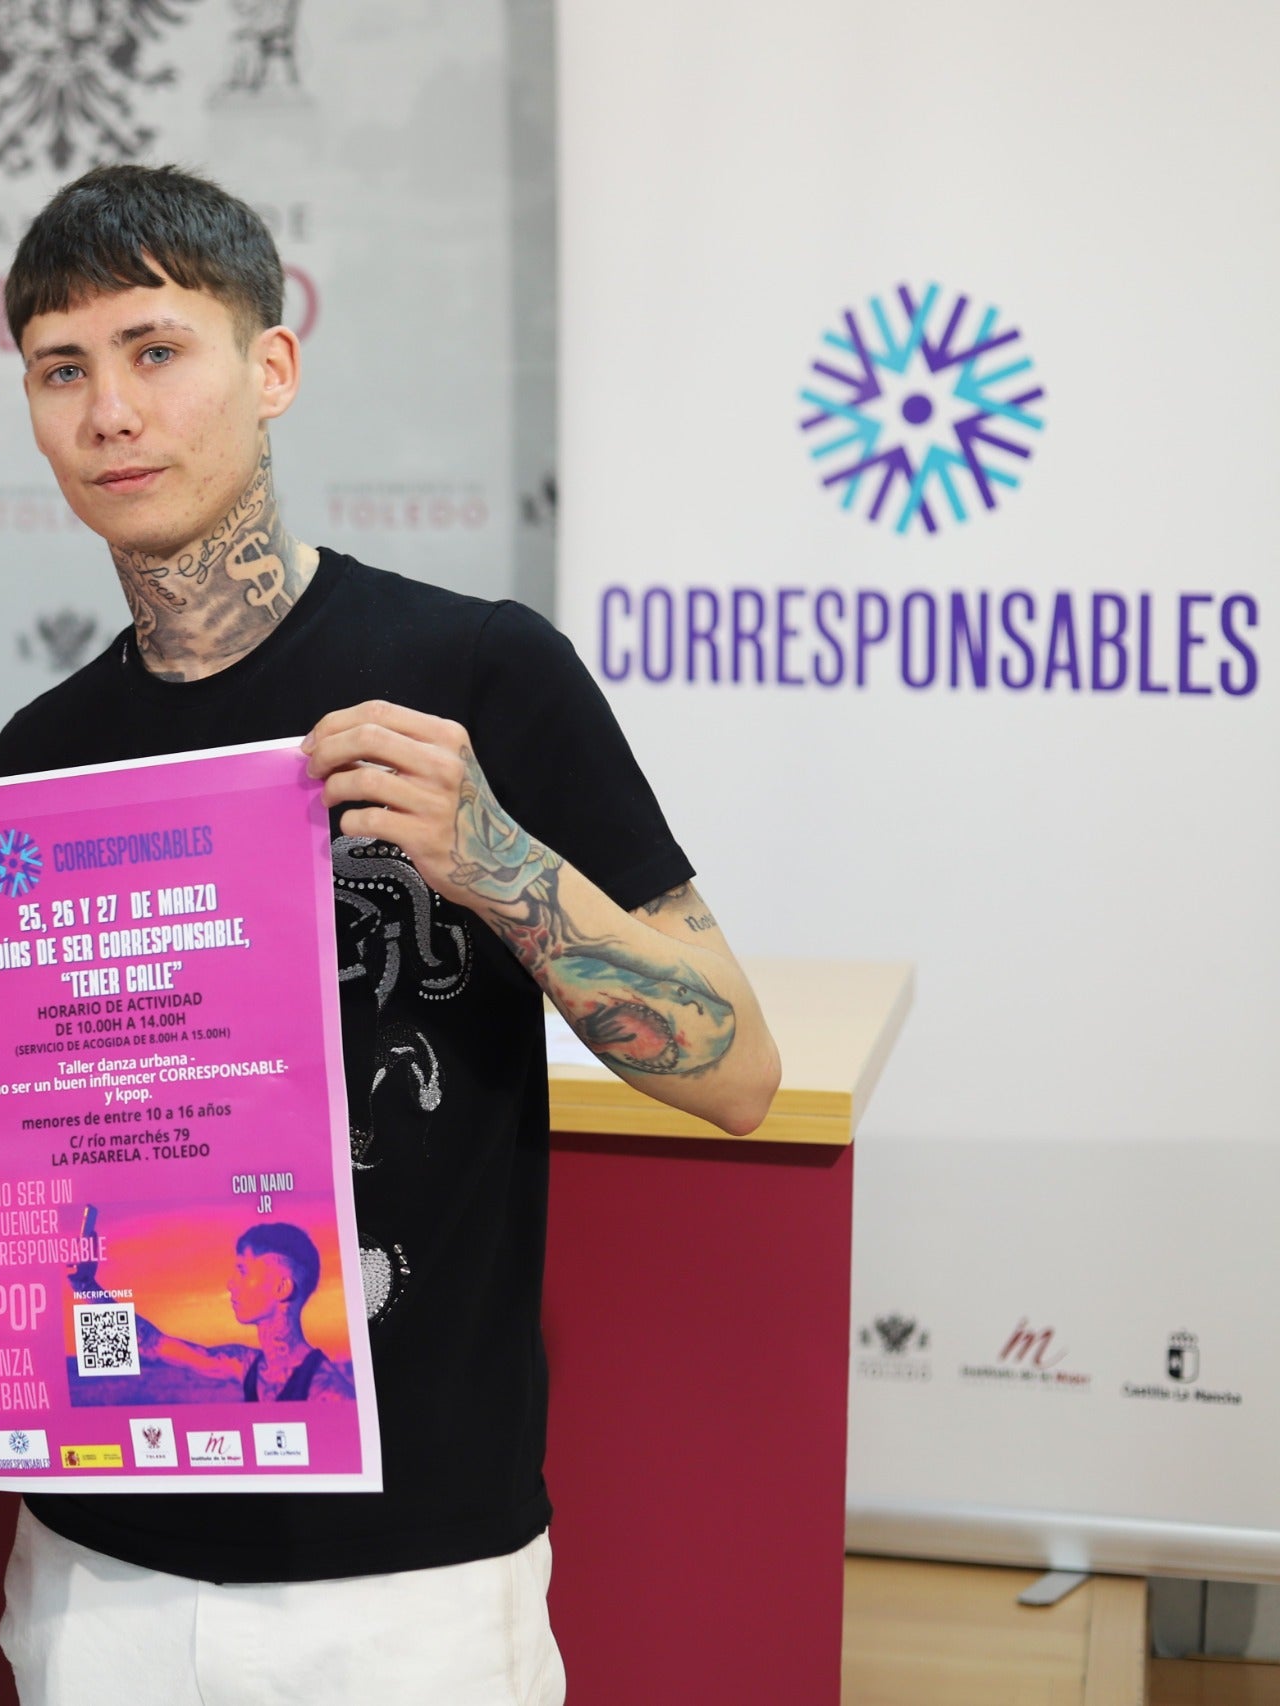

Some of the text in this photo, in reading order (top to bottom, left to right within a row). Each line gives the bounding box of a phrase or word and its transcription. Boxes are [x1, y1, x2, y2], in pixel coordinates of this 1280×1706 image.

[600, 585, 1260, 696] CORRESPONSABLES
[53, 825, 213, 872] CORRESPONSABLES
[18, 883, 217, 931] 25, 26 Y 27 DE MARZO
[36, 937, 58, 965] DE
[62, 934, 93, 962] SER
[98, 917, 250, 959] CORRESPONSABLE,
[38, 992, 202, 1020] HORARIO DE ACTIVIDAD
[55, 1012, 186, 1037] DE 10.00H A 14.00H
[15, 1028, 231, 1057] (SERVICIO DE ACOGIDA DE 8.00H A 15.00H)
[11, 1082, 32, 1094] ser
[34, 1081, 51, 1092] un
[54, 1077, 87, 1090] buen
[90, 1072, 156, 1088] influencer
[159, 1059, 288, 1082] CORRESPONSABLE-
[58, 1054, 188, 1075] Taller danza urbana
[104, 1088, 152, 1106] y kpop.
[22, 1103, 232, 1130] menores de entre 10 a 16 años
[70, 1128, 190, 1149] C/ río marchés 79
[52, 1143, 210, 1167] LA PASARELA TOLEDO
[17, 1180, 46, 1206] SER
[51, 1178, 72, 1204] UN
[232, 1172, 294, 1194] CON NANO
[257, 1195, 272, 1214] JR
[72, 1288, 133, 1300] INSCRIPCIONES
